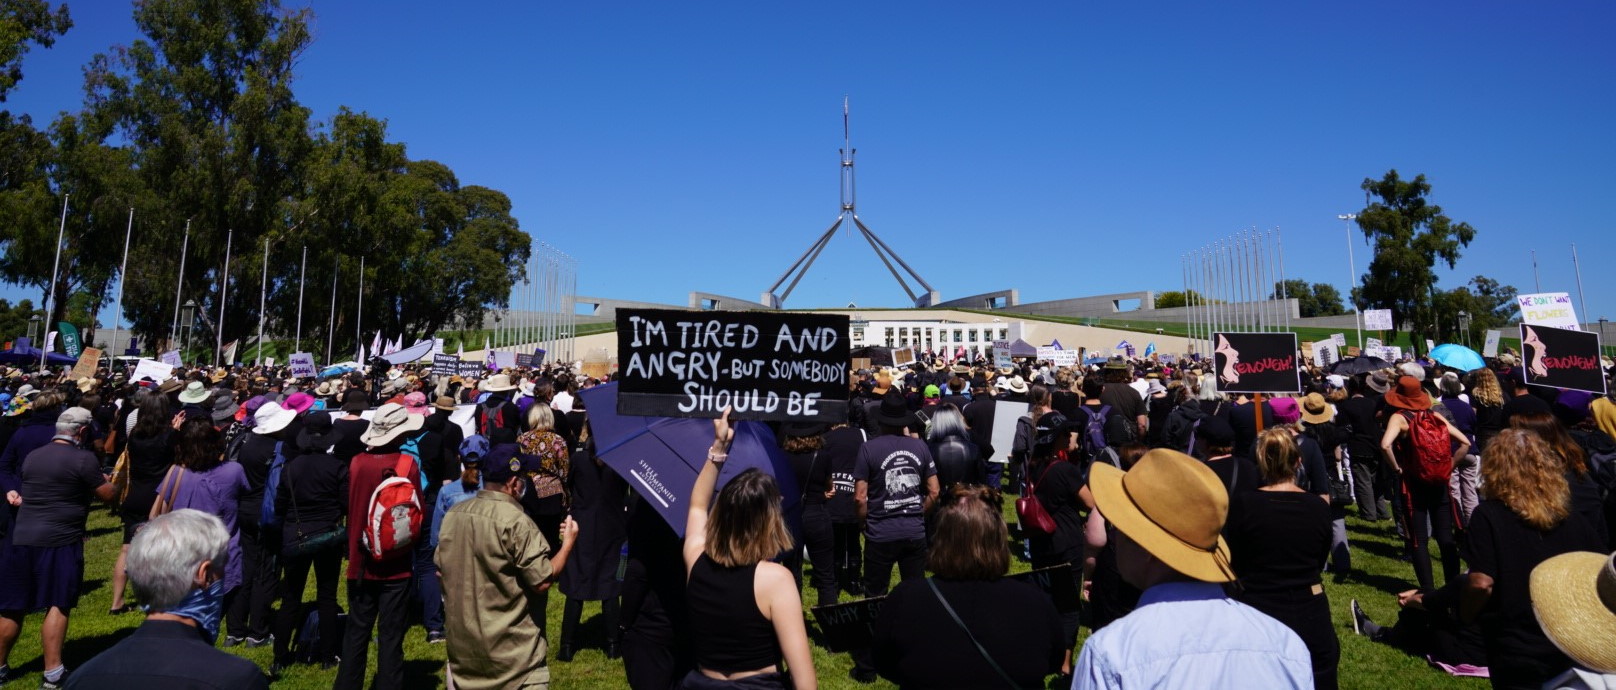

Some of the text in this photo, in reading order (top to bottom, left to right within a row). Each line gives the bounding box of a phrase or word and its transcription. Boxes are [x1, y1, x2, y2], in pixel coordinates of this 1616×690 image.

[1520, 296, 1533, 307] WE
[1556, 296, 1570, 304] WANT
[1527, 308, 1569, 320] FLOWERS
[629, 316, 838, 354] I'M TIRED AND
[768, 359, 846, 385] SOMEBODY
[1236, 355, 1294, 374] ENOUGH!
[1543, 354, 1598, 370] ENOUGH!
[678, 382, 822, 416] SHOULD BE
[646, 471, 676, 502] COMPANIES
[822, 606, 858, 626] WHY
